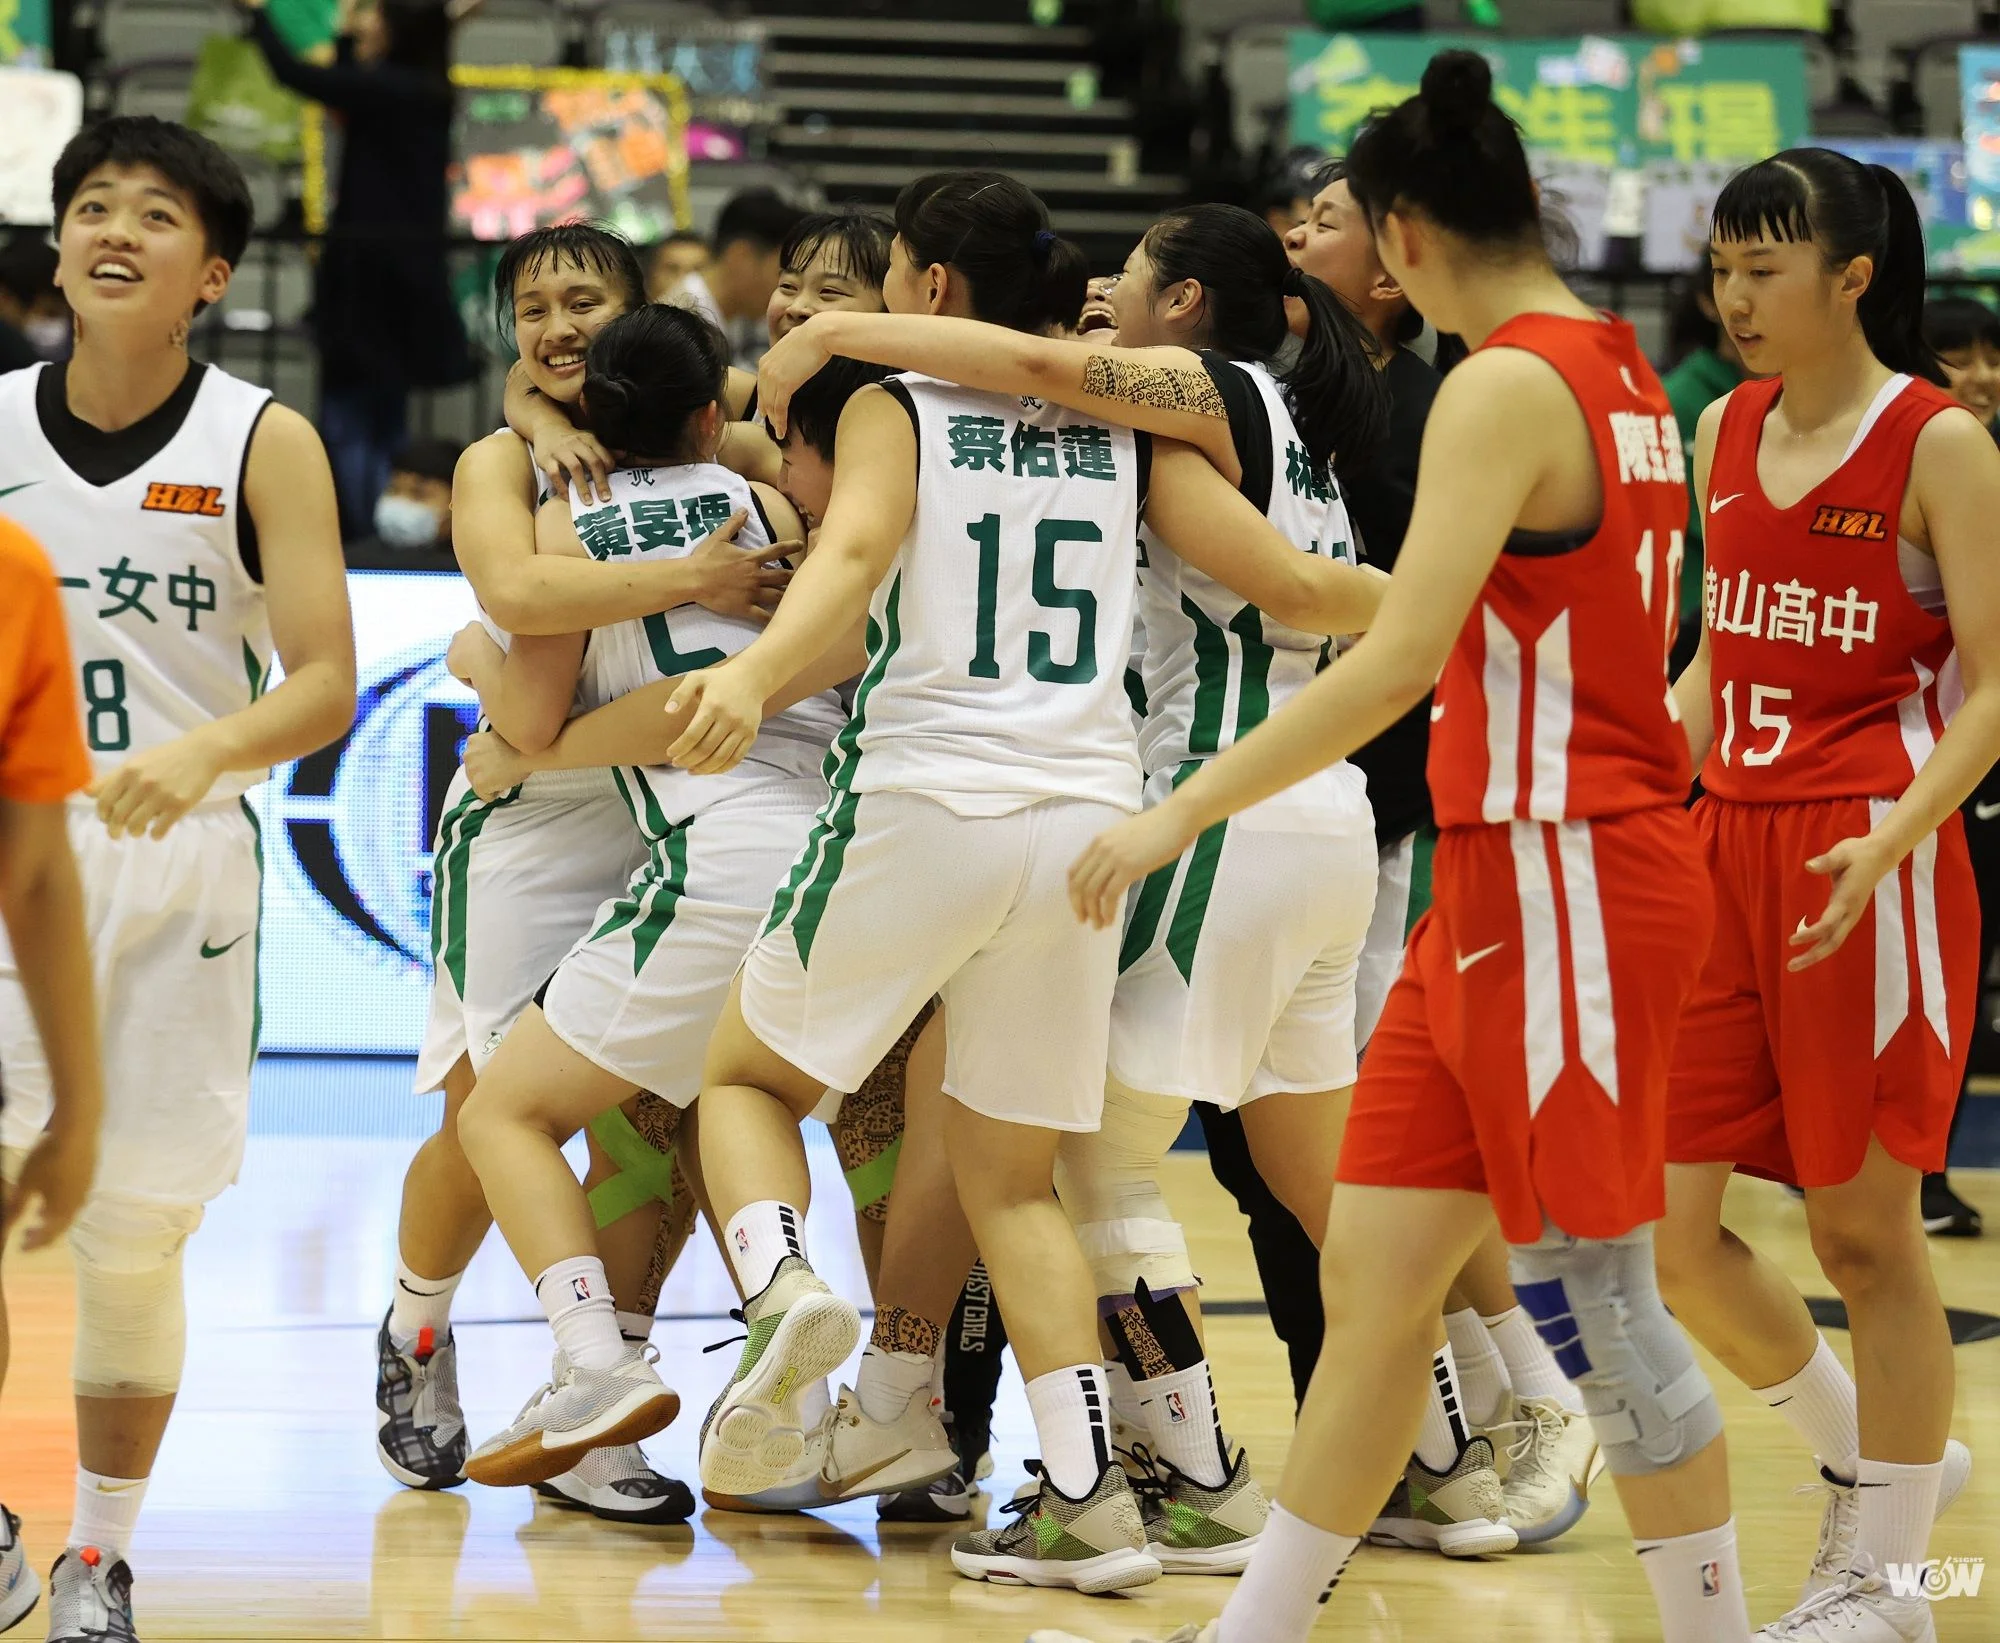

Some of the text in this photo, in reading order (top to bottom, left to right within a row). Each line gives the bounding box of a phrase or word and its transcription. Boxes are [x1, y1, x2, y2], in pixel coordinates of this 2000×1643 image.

[947, 414, 1118, 482] 蔡佑蓮
[966, 512, 1103, 685] 15
[83, 658, 131, 751] 8
[1720, 680, 1793, 768] 15
[959, 1304, 989, 1353] GIRLS
